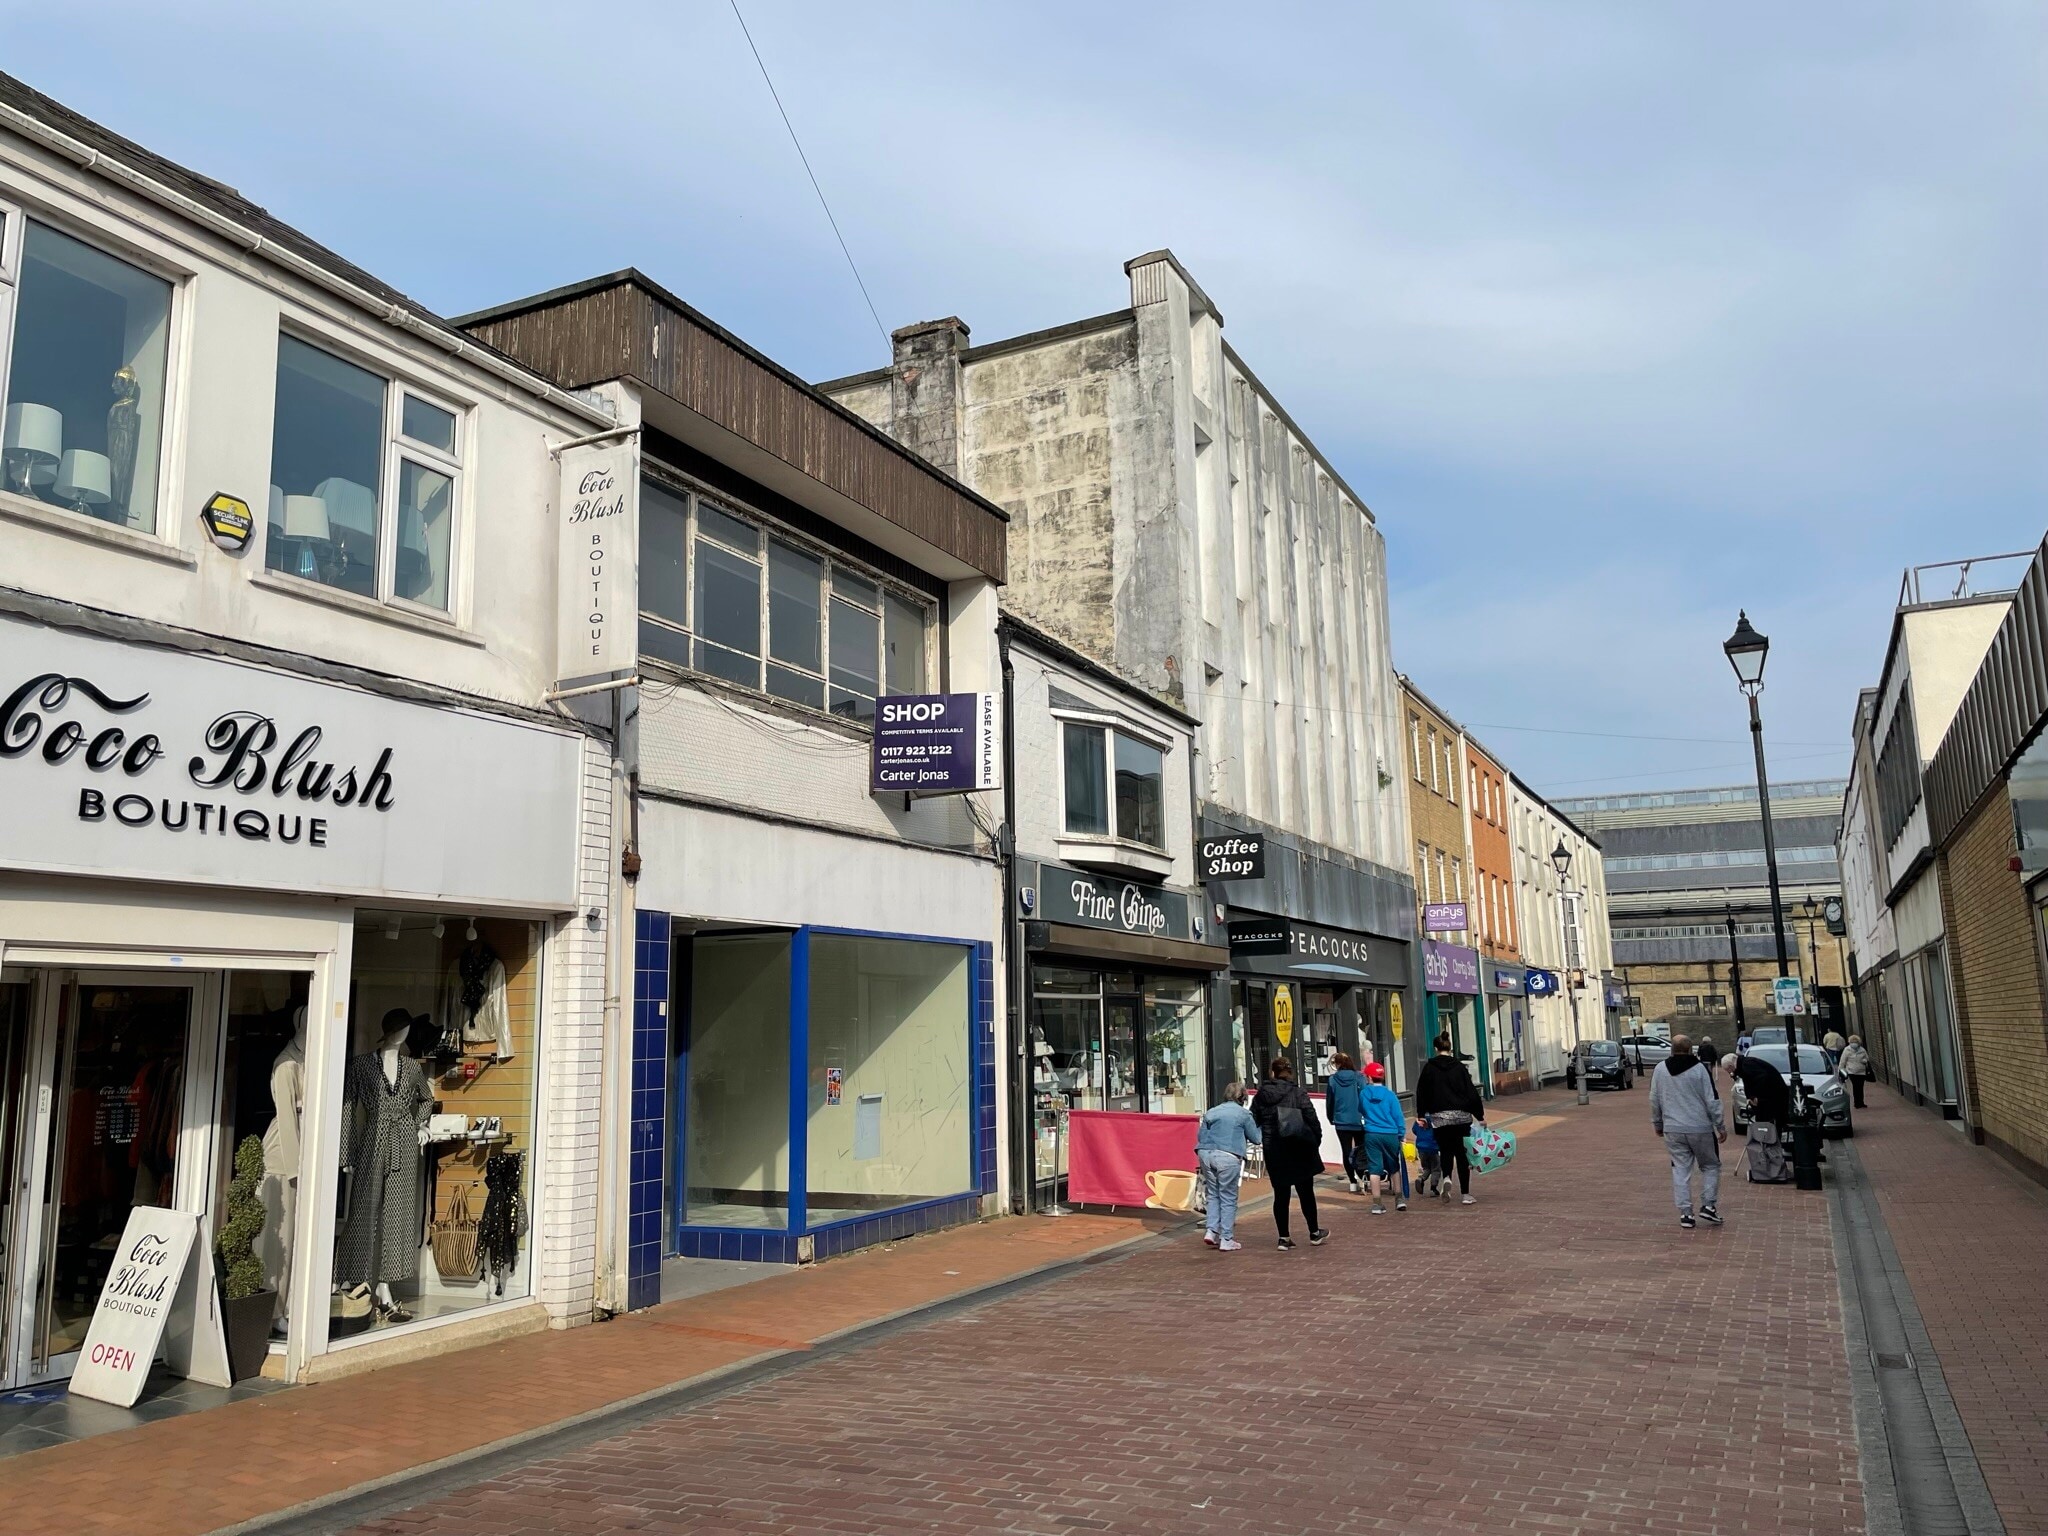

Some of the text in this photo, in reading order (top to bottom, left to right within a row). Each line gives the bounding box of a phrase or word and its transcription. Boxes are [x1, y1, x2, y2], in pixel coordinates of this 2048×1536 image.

[578, 468, 615, 495] Coco
[569, 494, 625, 524] Blush
[589, 534, 604, 656] BOUTIQUE
[882, 703, 945, 722] SHOP
[0, 673, 395, 810] Coco Blush
[881, 745, 953, 756] 0117 922 1222
[983, 695, 992, 785] LEASE AVAILABLE
[880, 757, 930, 765] carterjonas.co.uk
[880, 768, 950, 783] Carter Jonas
[79, 788, 328, 845] BOUTIQUE
[1203, 839, 1259, 858] Coffee
[1208, 857, 1254, 875] Shop
[1071, 880, 1165, 934] Fine China
[1429, 907, 1463, 920] enfys
[1231, 932, 1284, 940] PEACOCKS
[1426, 949, 1448, 986] enfys
[130, 1233, 170, 1266] Coco
[109, 1264, 169, 1302] Blush
[103, 1298, 158, 1318] BOUTIQUE
[91, 1343, 136, 1372] OPEN
